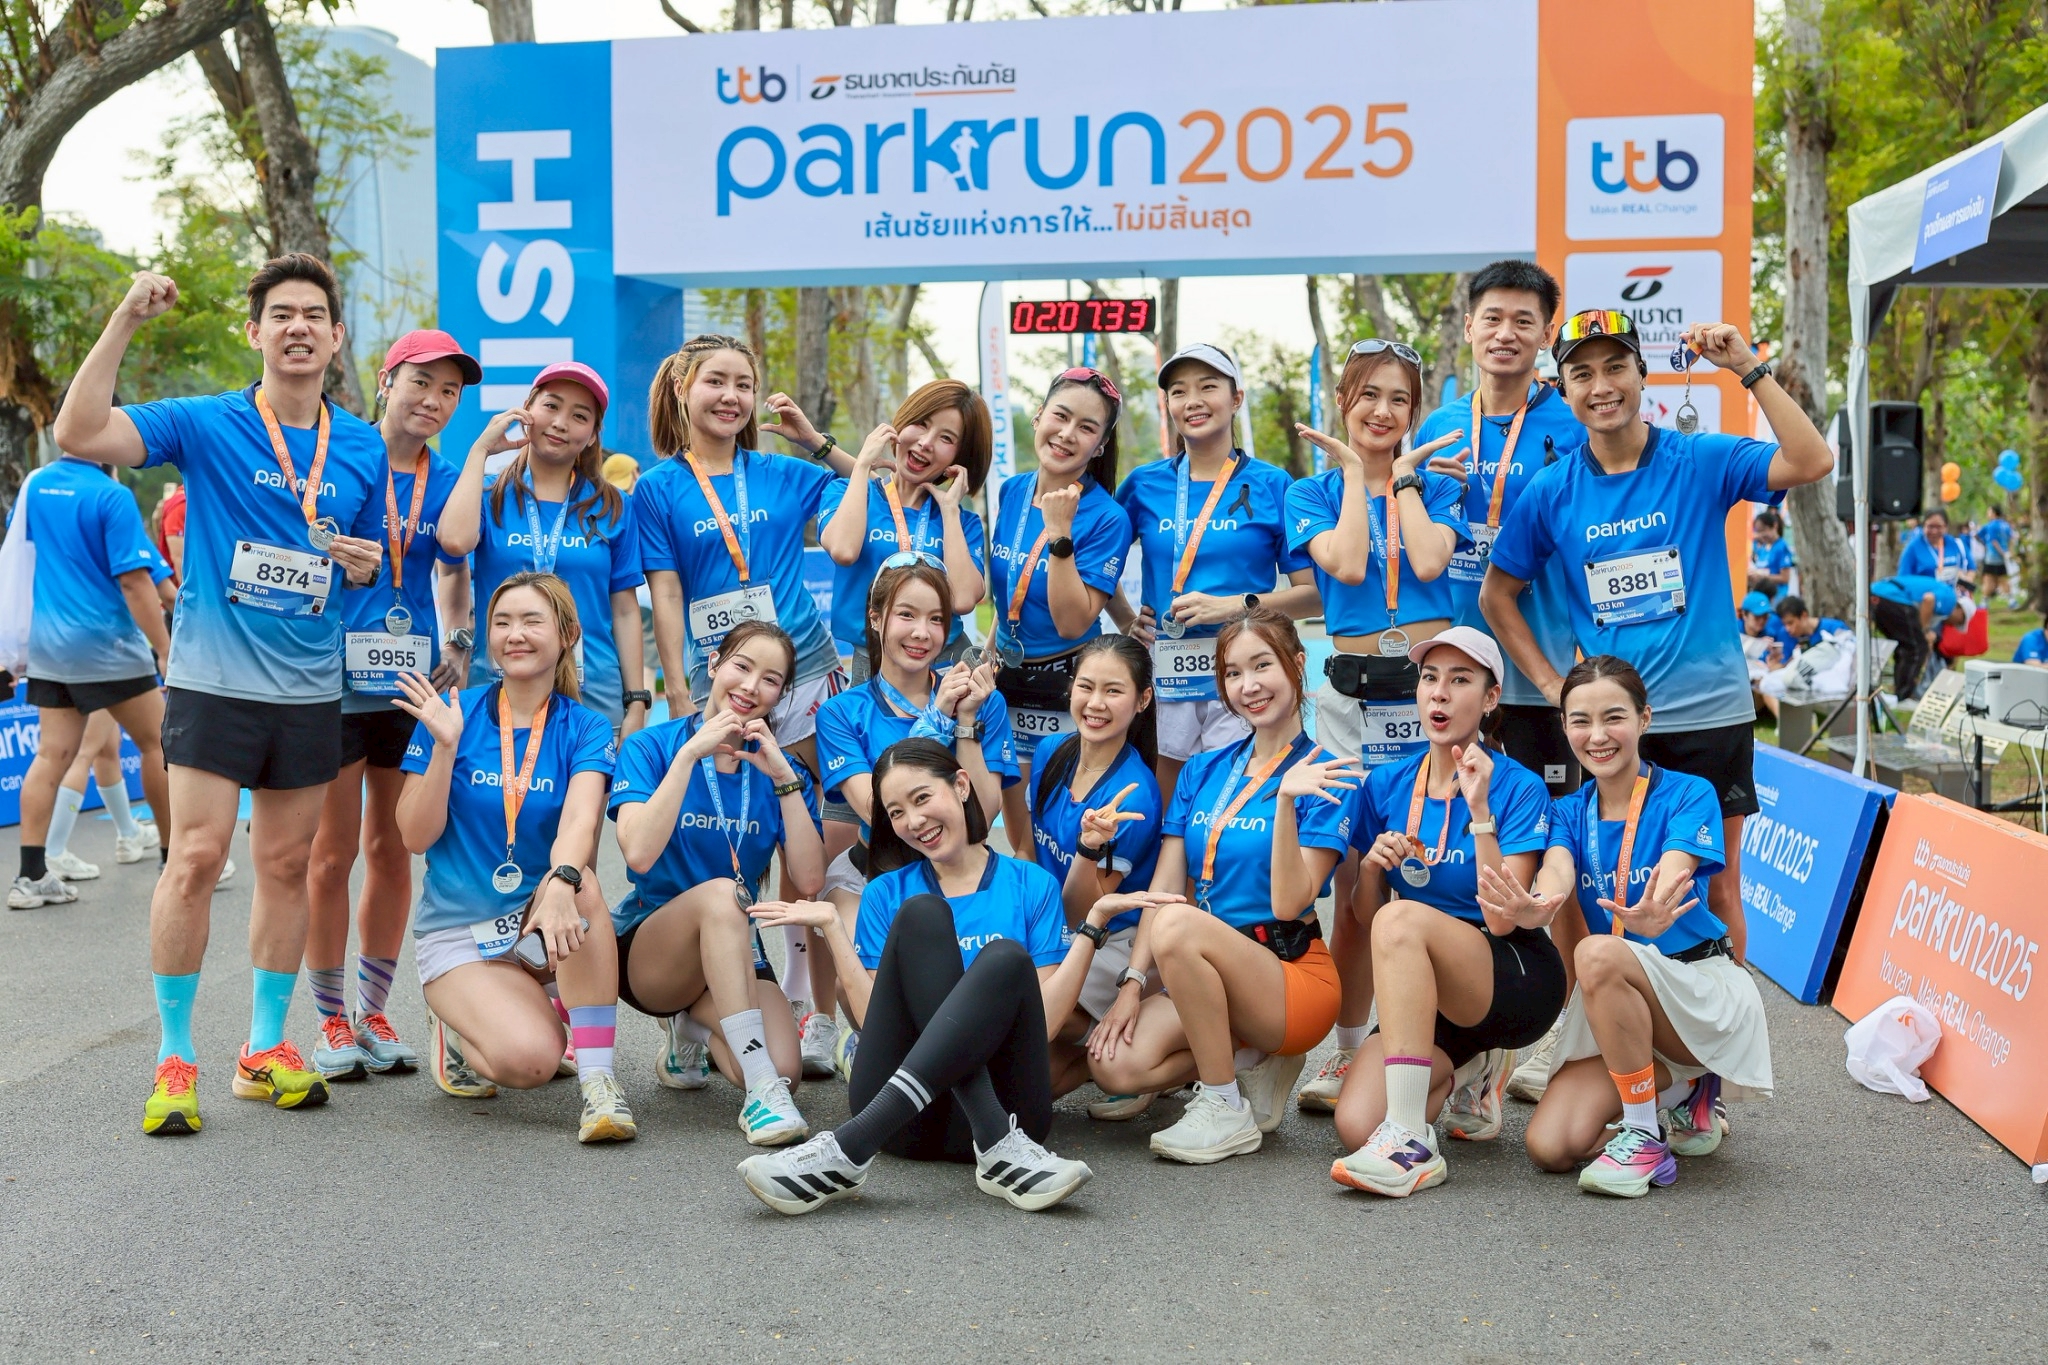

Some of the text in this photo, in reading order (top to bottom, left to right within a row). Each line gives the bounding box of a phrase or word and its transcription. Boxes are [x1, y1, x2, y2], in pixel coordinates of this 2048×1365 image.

[716, 66, 786, 104] ttb
[844, 62, 1016, 91] ธนชาตประกันภัย
[716, 102, 1414, 216] parkrun2025
[1592, 140, 1699, 193] ttb
[1621, 203, 1651, 214] REAL
[254, 469, 336, 498] parun
[1586, 511, 1667, 543] parkrun
[257, 562, 310, 589] 8374
[1464, 561, 1477, 569] km
[234, 581, 253, 592] 10.5
[253, 585, 269, 595] km
[1608, 570, 1658, 595] 8381
[1597, 603, 1611, 611] 10.5
[707, 610, 735, 630] 83
[699, 636, 713, 646] 10.5
[367, 649, 416, 668] 9955
[351, 671, 384, 679] 10.5 km
[1017, 713, 1060, 732] 8373
[1366, 710, 1414, 718] parkrun2025
[406, 743, 423, 757] ttb
[828, 755, 846, 771] ttb
[471, 769, 554, 793] parun
[613, 779, 630, 792] ttb
[1913, 837, 1930, 869] ttb
[1618, 845, 1629, 898] parkrun2025
[1752, 882, 1773, 915] REAL
[1769, 893, 1797, 934] Change
[1889, 879, 2039, 1002] parkrun2025
[1880, 950, 1897, 985] You
[1916, 975, 1942, 1015] Make
[1940, 990, 1970, 1036] REAL
[1968, 1010, 2011, 1068] Change
